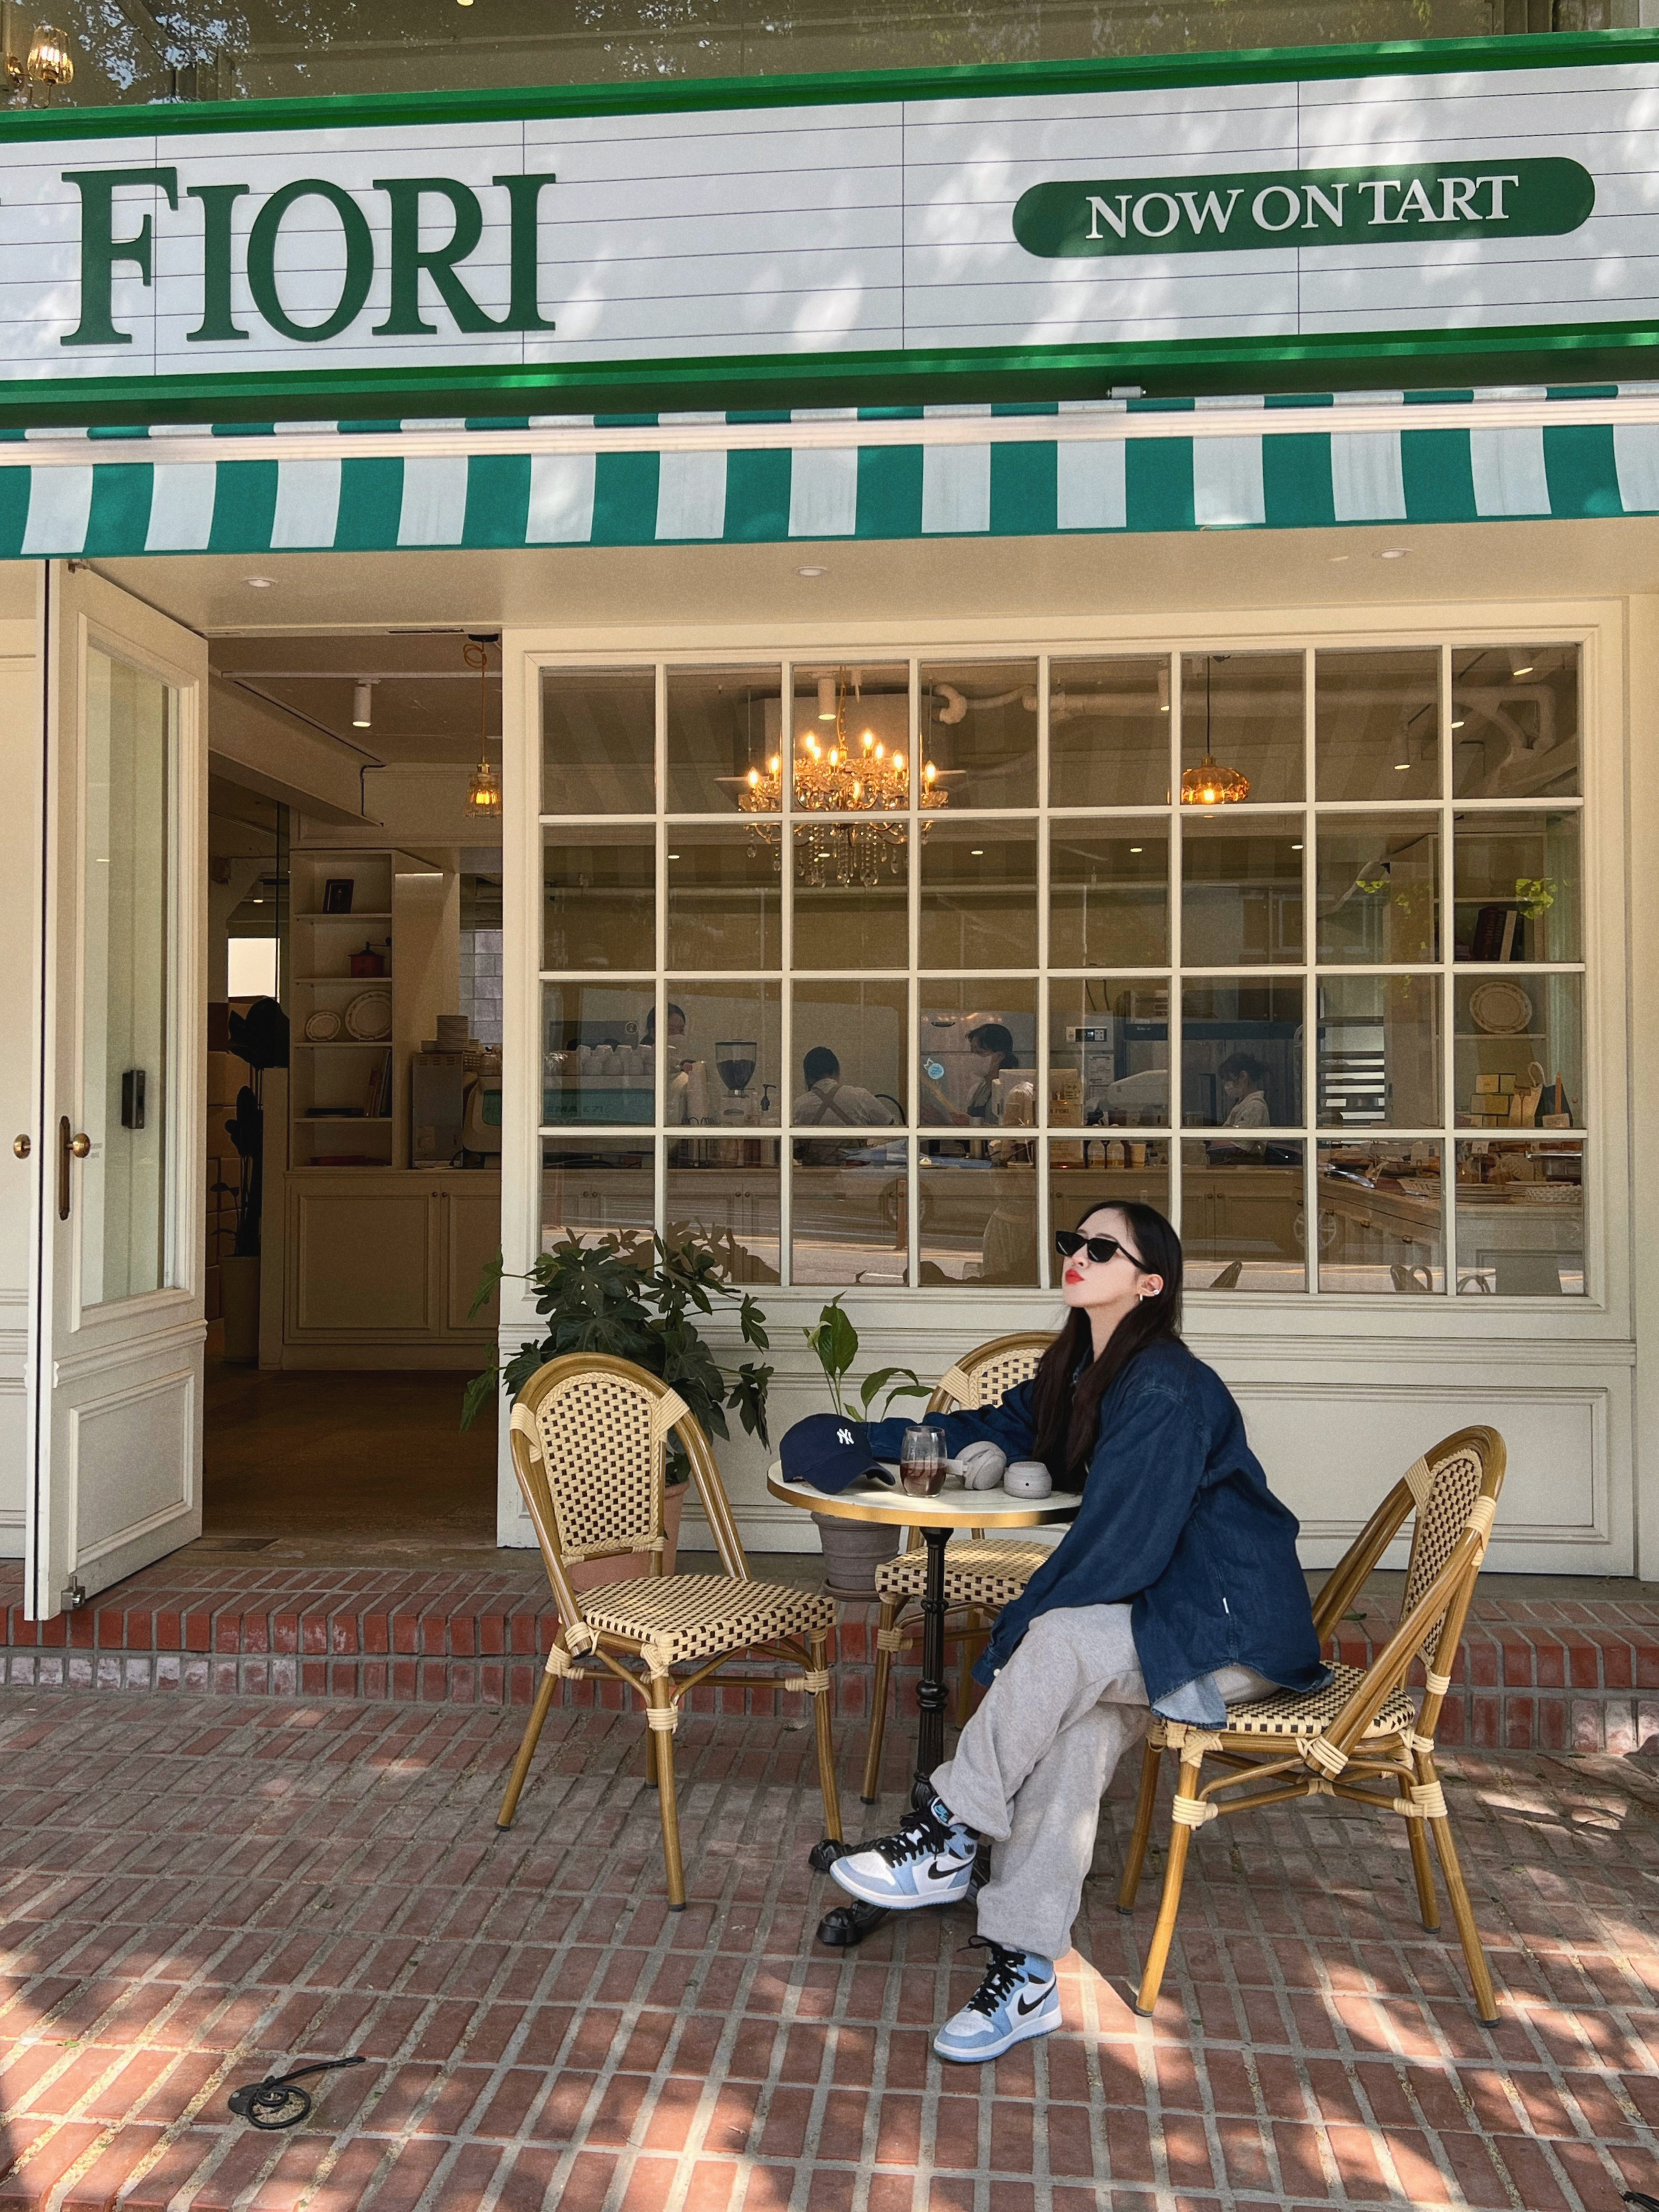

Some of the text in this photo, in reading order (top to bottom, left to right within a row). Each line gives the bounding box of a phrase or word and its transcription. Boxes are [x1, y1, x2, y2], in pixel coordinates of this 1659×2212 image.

[60, 166, 556, 346] FIORI
[1085, 175, 1519, 239] NOW ON TART
